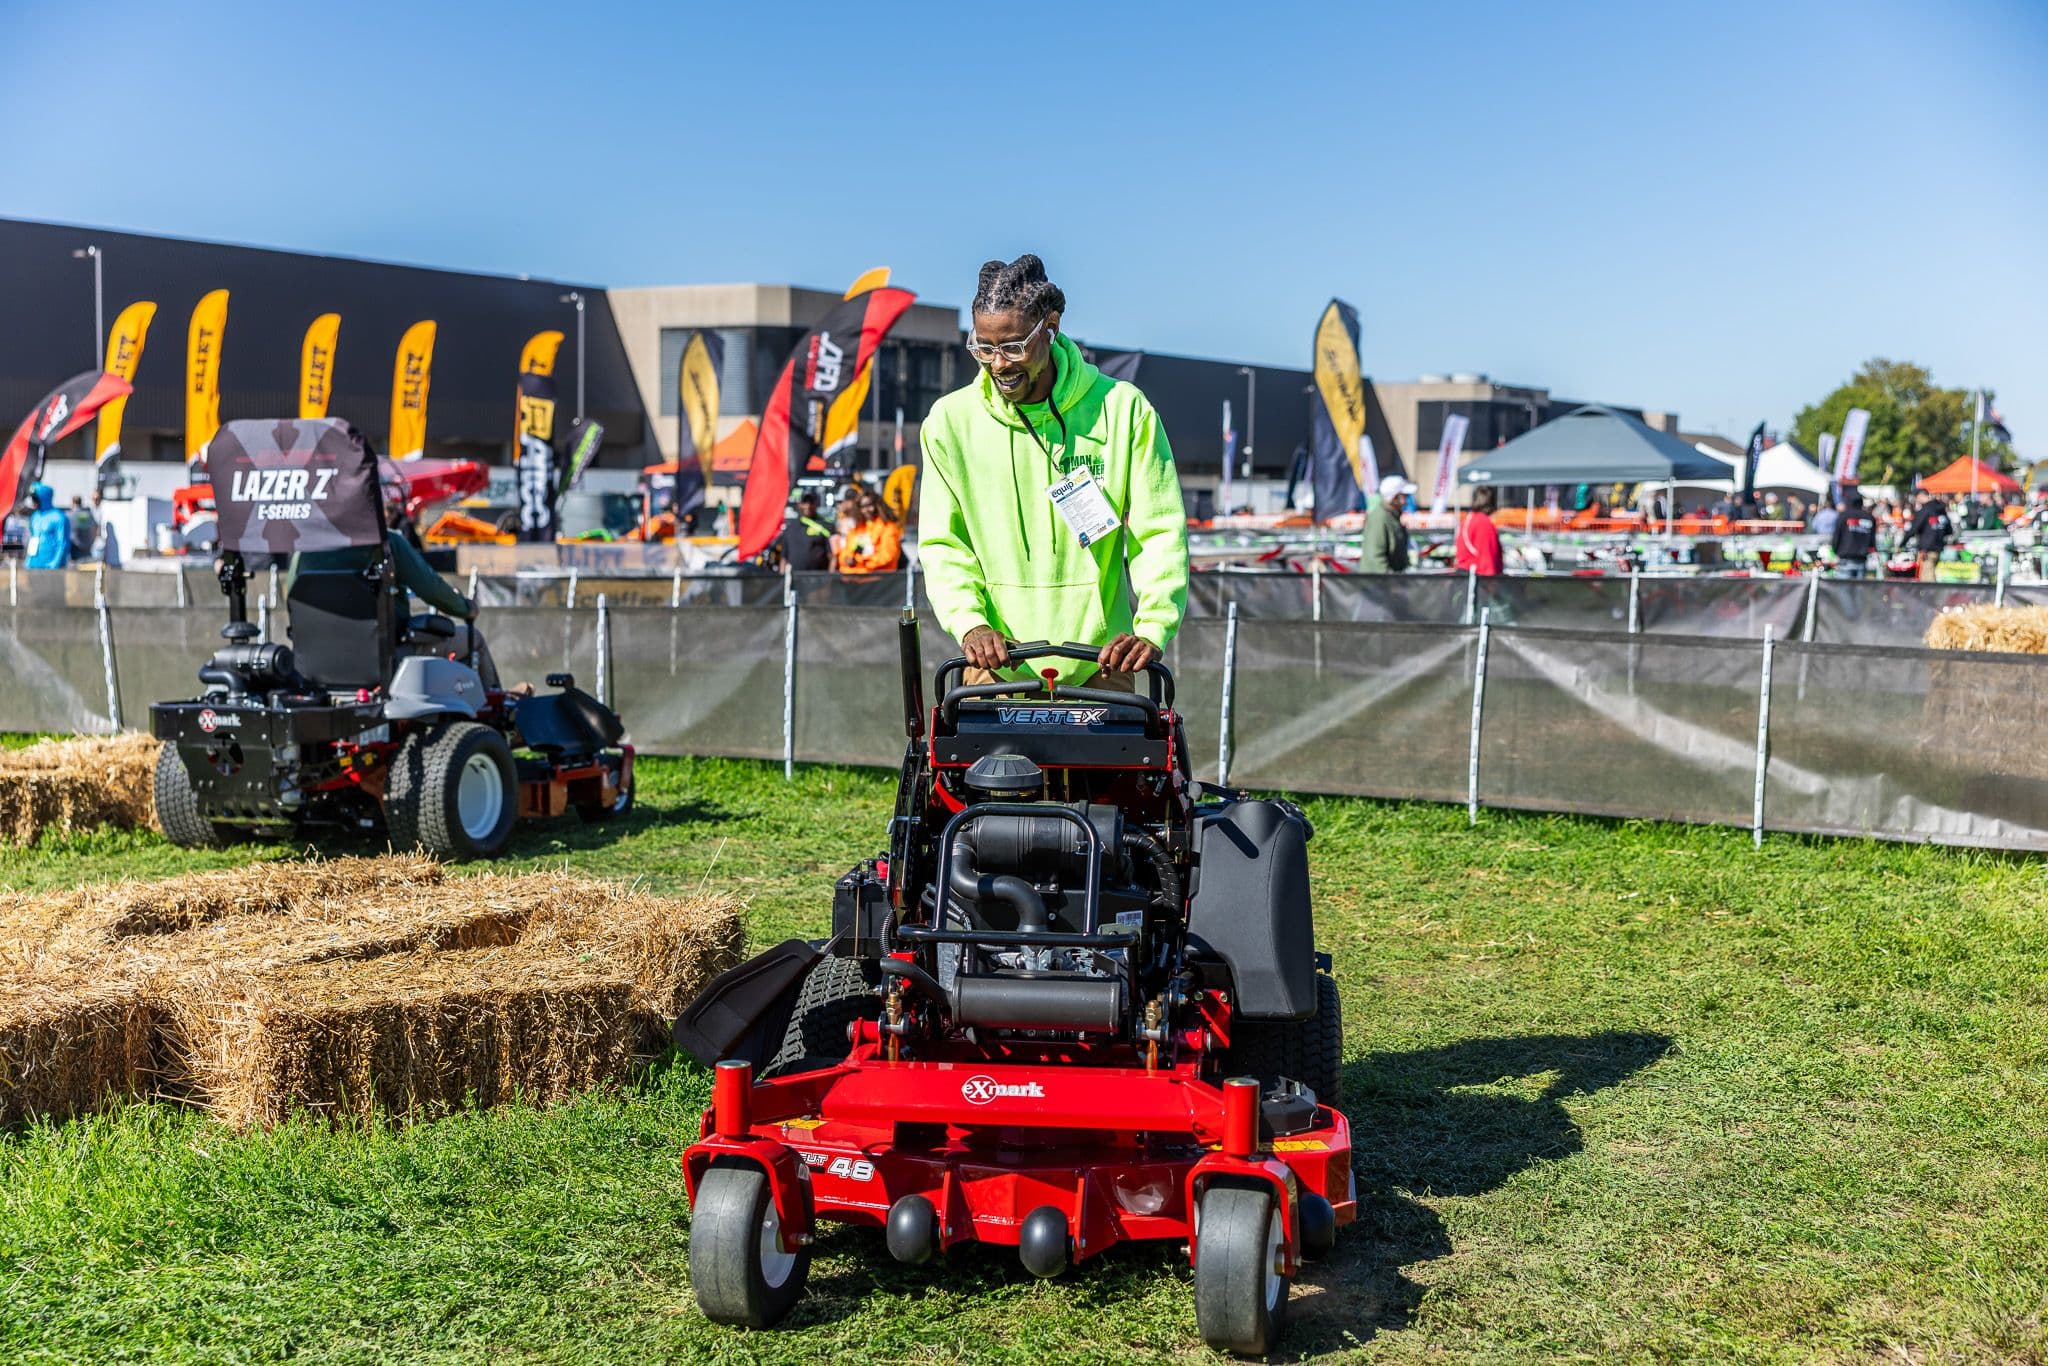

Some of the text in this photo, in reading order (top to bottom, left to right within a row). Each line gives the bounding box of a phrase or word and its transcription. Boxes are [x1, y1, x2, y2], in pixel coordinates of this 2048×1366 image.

[231, 469, 309, 501] LAZER
[1052, 481, 1074, 498] equip
[257, 503, 311, 520] E-SERIES
[997, 707, 1108, 726] VERTEX
[828, 1157, 875, 1182] 48
